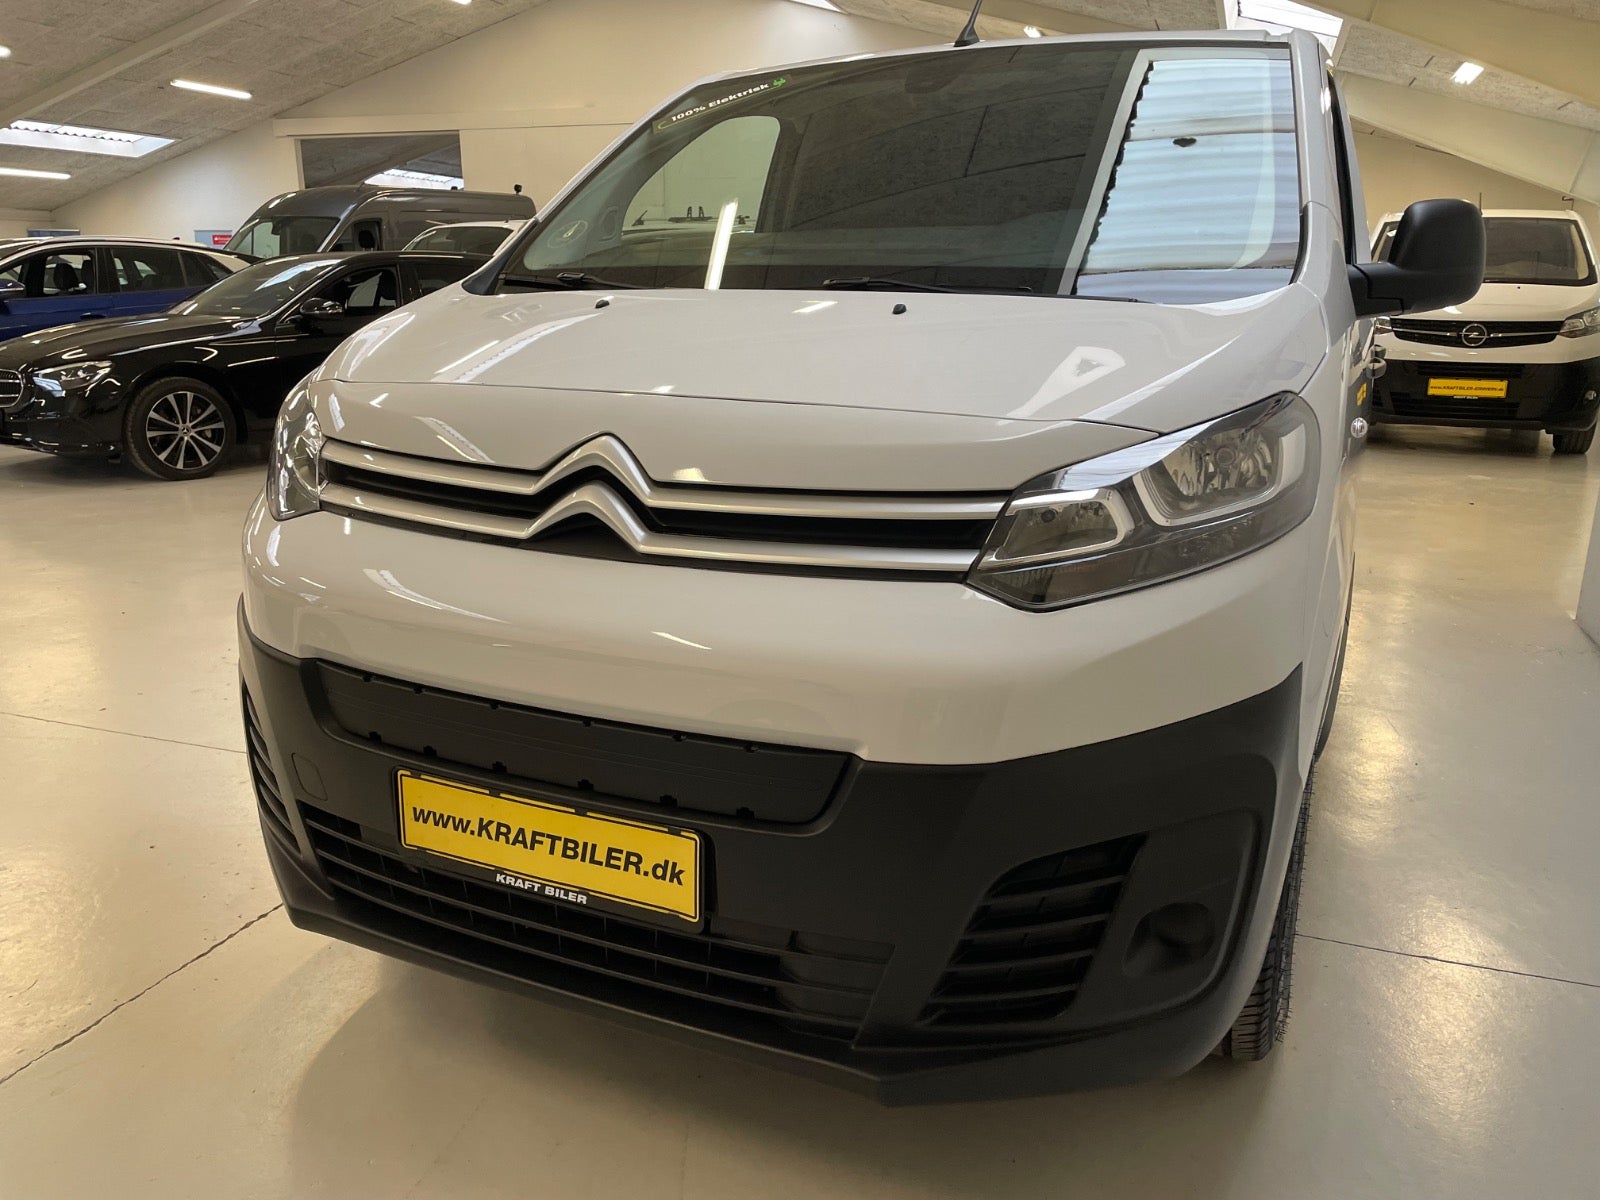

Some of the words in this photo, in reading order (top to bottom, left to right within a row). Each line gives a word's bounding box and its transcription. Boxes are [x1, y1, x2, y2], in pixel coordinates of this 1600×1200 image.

[671, 105, 707, 122] 100%
[708, 82, 770, 108] Elektrisk
[411, 806, 686, 886] www.KRAFTBILER.dk
[495, 872, 541, 893] KRAFT
[544, 885, 588, 906] BILER
